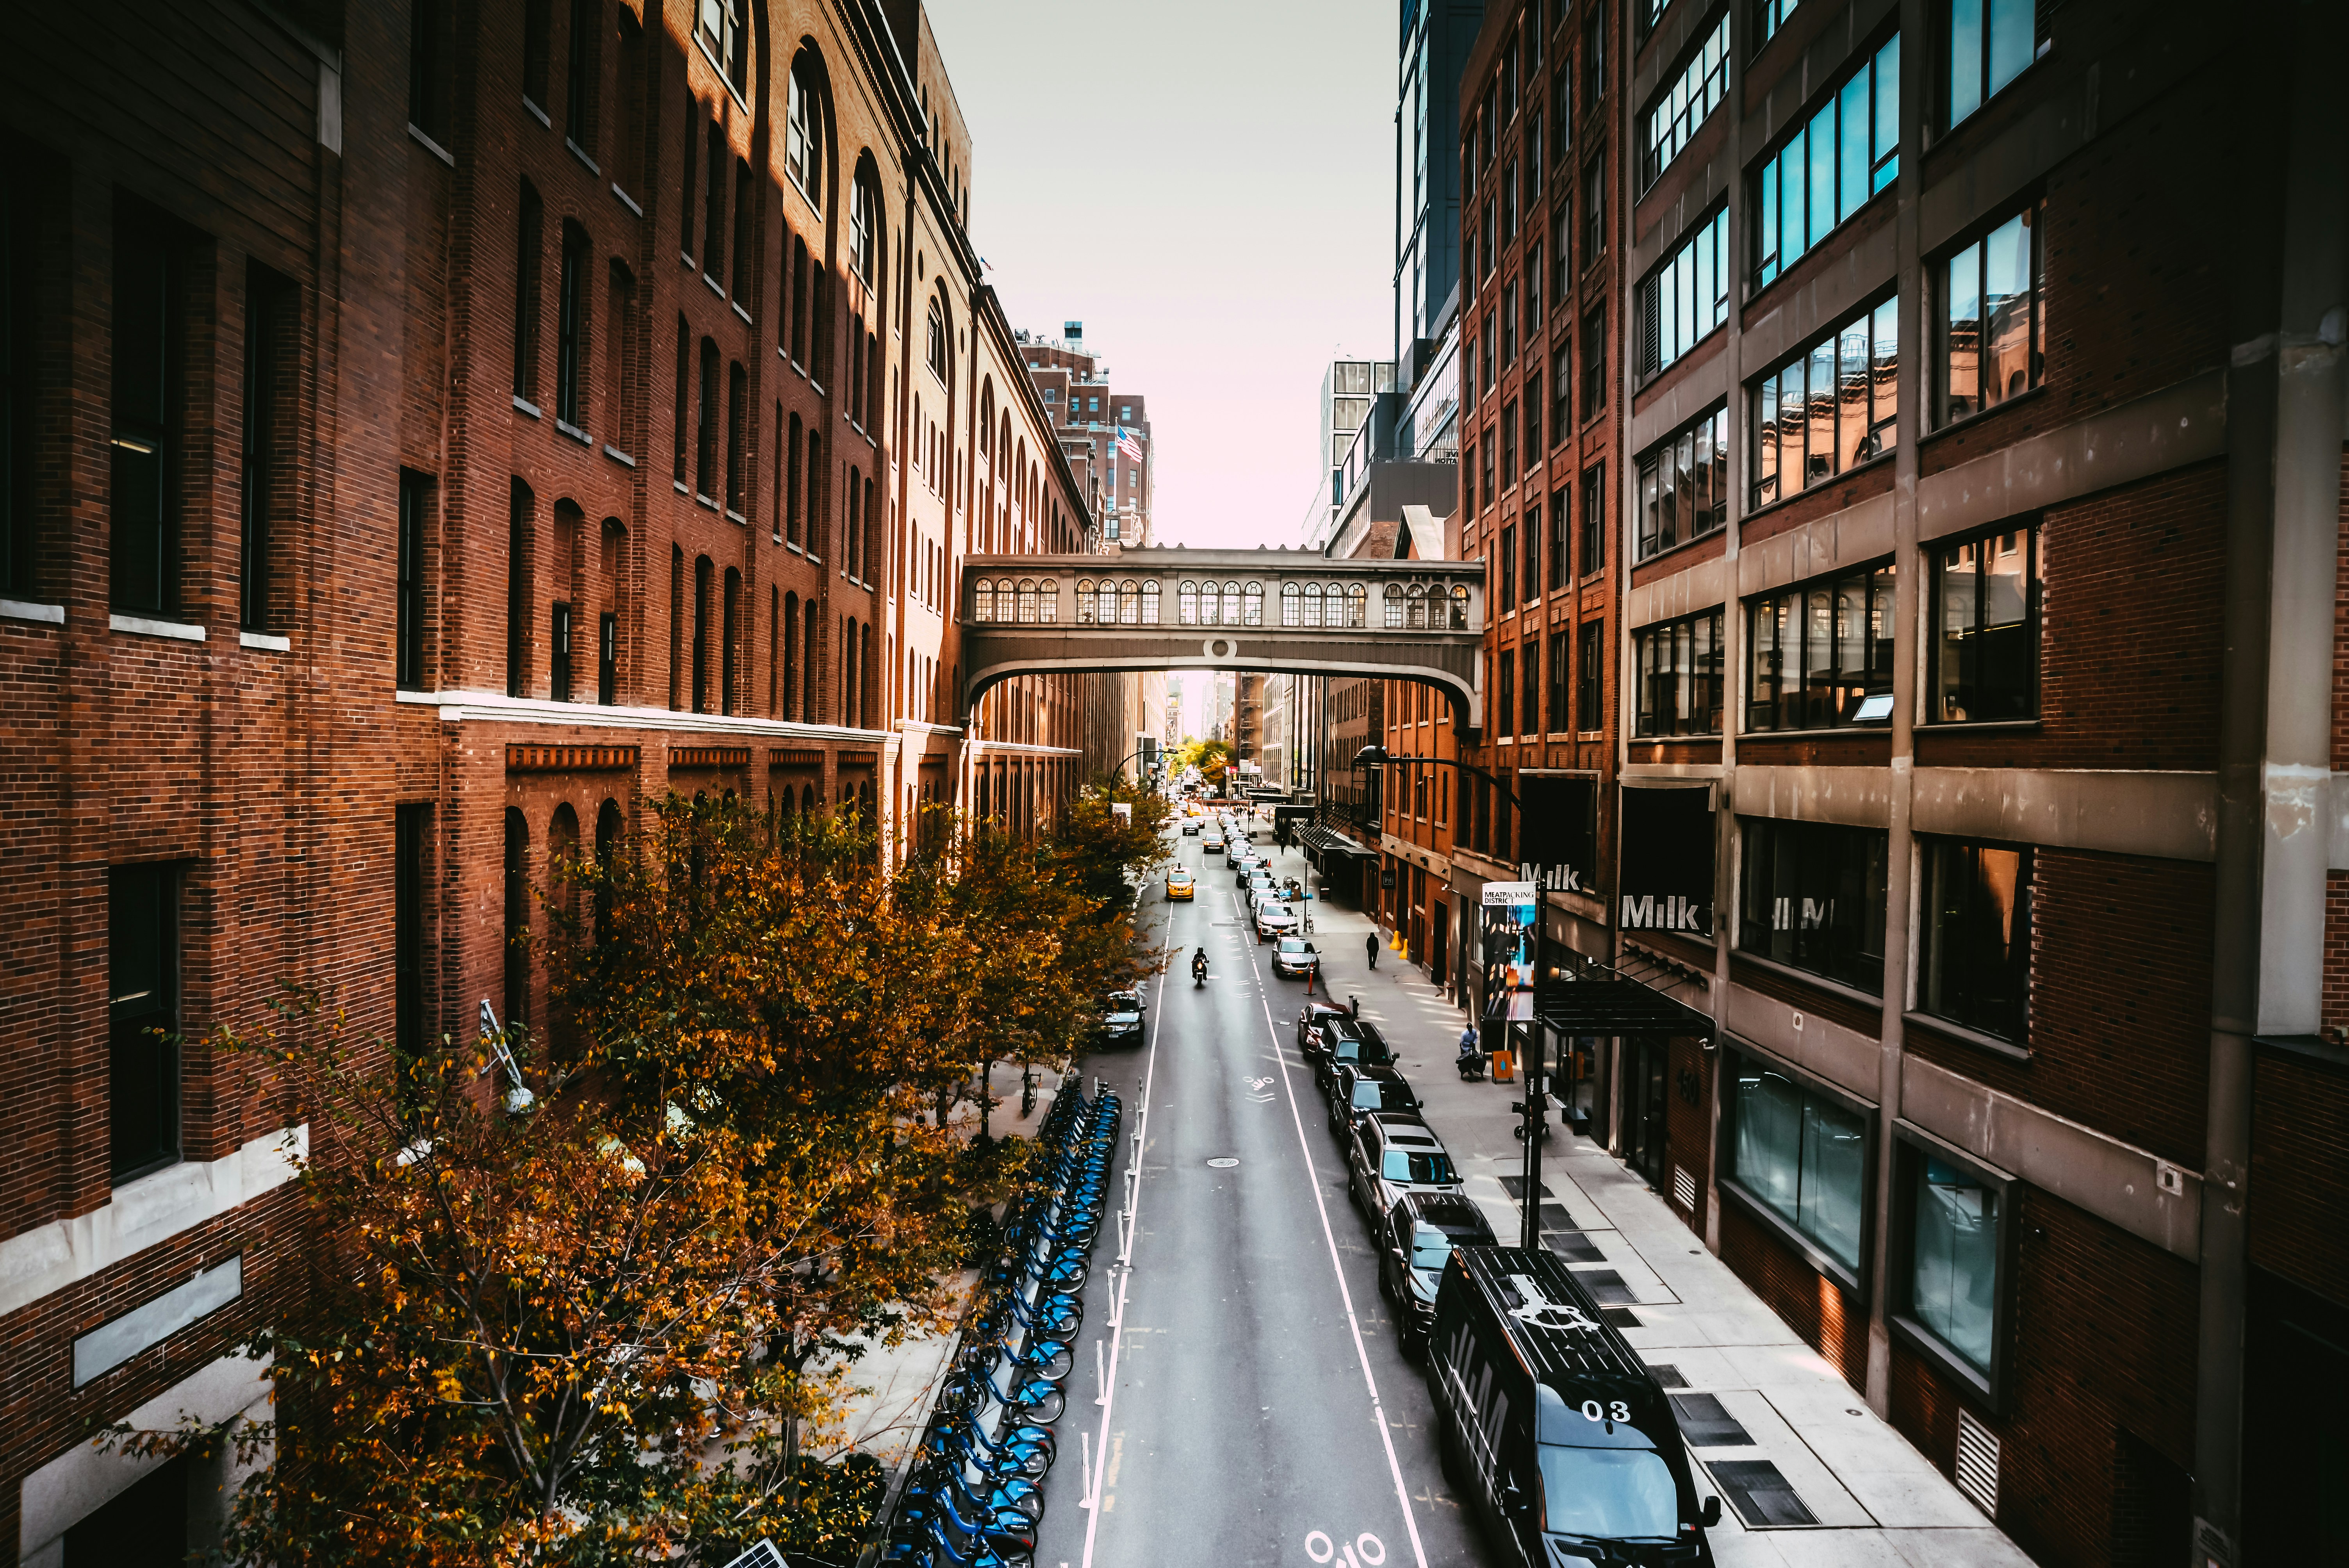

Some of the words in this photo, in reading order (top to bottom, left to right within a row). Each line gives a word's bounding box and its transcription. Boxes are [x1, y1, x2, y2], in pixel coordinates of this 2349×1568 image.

[1522, 863, 1579, 890] Milk
[1622, 895, 1700, 930] Milk
[1582, 1400, 1631, 1422] 03
